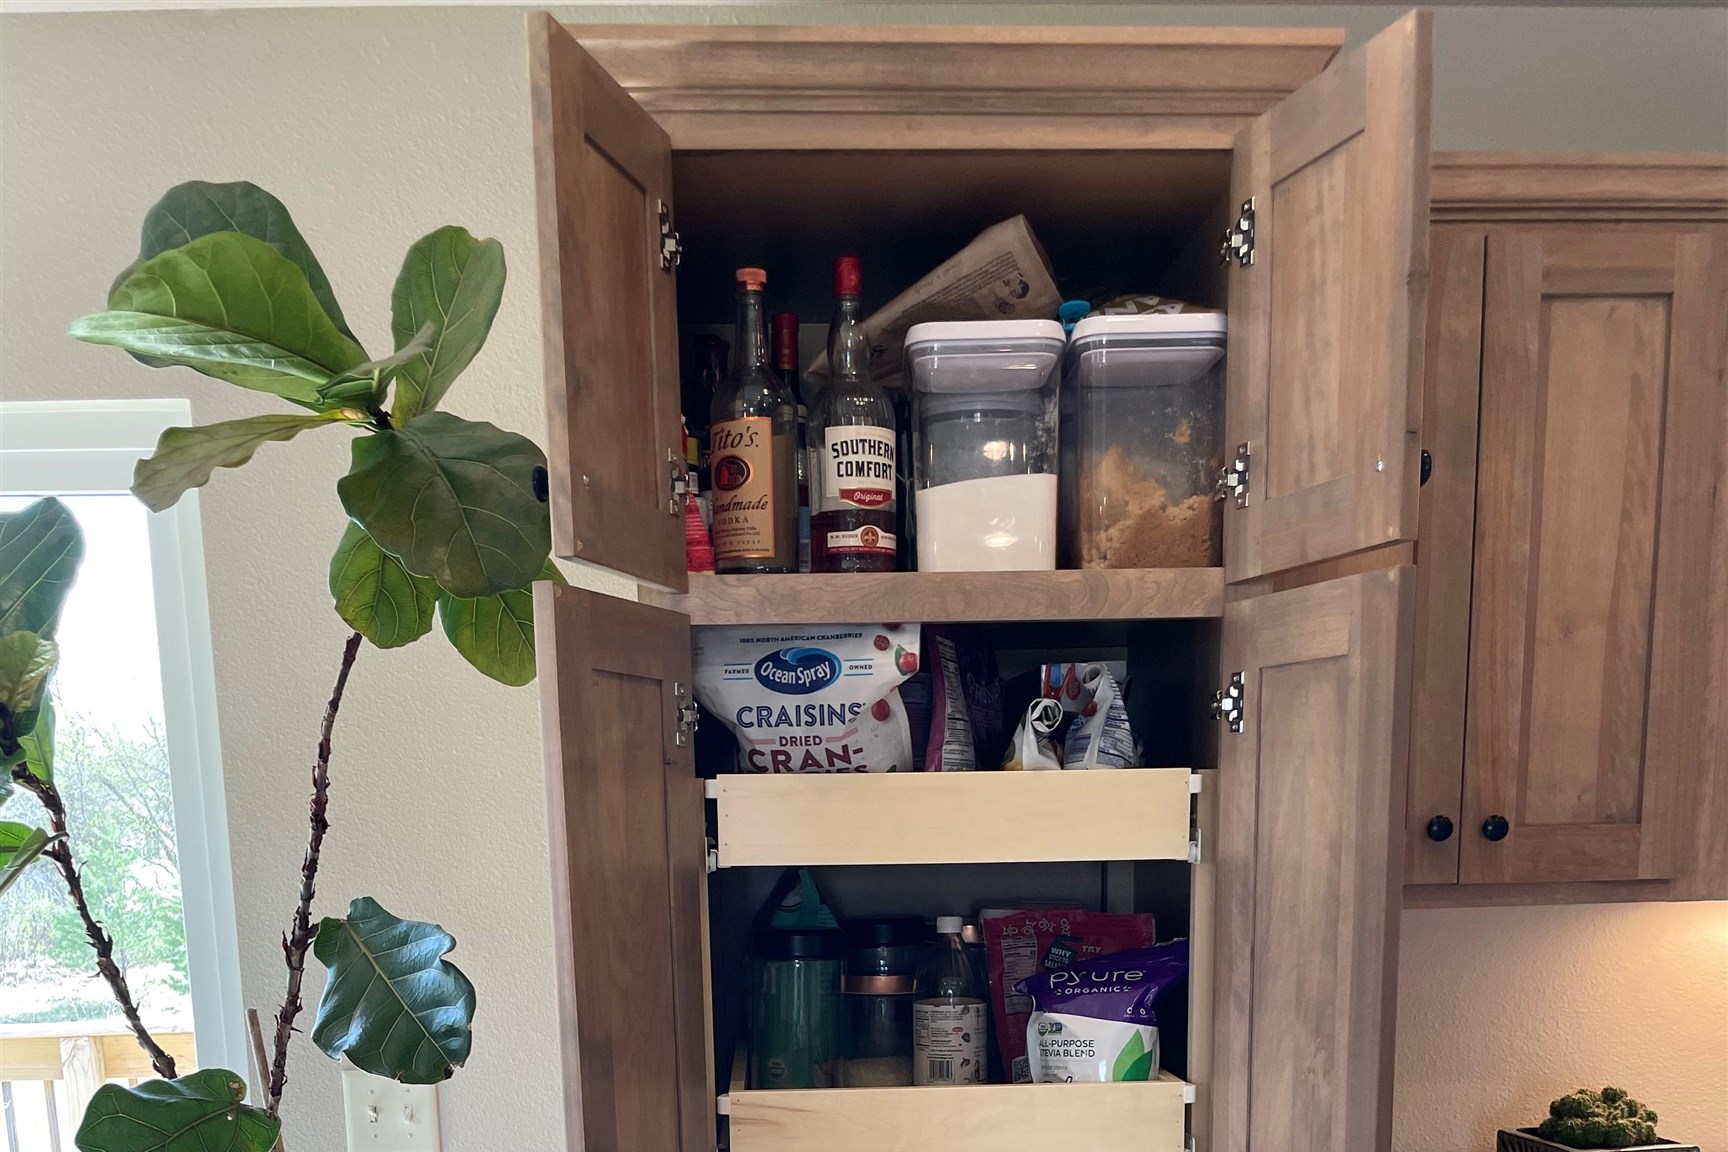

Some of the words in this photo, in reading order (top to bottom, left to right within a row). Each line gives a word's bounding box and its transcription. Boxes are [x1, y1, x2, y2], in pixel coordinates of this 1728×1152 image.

[831, 439, 894, 462] SOUTHERN
[837, 461, 893, 480] COMFORT
[854, 491, 884, 502] Original
[780, 634, 816, 642] AMERICAN
[817, 633, 863, 641] CRANBERRIES
[760, 661, 796, 684] Ocean
[798, 661, 831, 687] Spray
[779, 736, 823, 747] DRIED
[748, 744, 864, 774] CRAN-
[1051, 947, 1072, 957] WHY
[1081, 945, 1102, 953] TRY
[1065, 986, 1121, 994] ORGANIC
[1039, 1039, 1094, 1048] ALL-PURPOSE
[1039, 1049, 1061, 1057] STEVIA
[1063, 1049, 1095, 1058] BLEND
